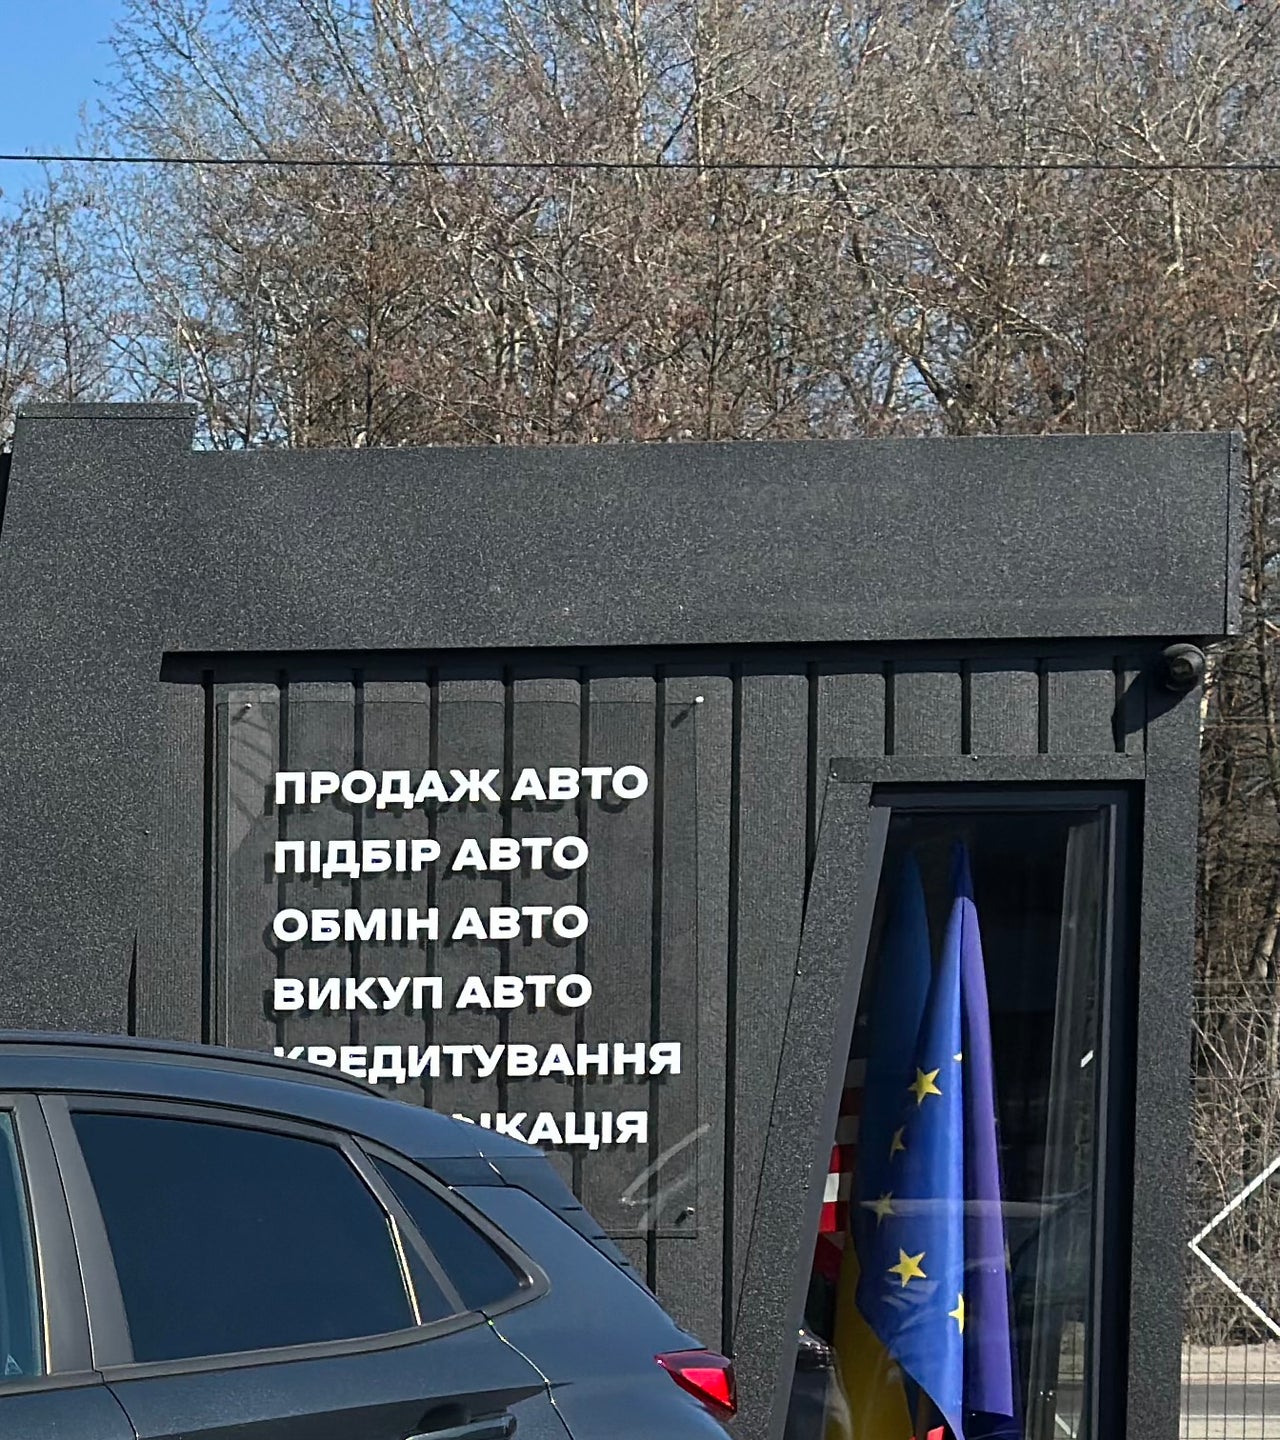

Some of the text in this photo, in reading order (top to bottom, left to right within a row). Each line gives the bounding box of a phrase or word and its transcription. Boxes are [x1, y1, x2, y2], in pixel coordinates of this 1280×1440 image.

[274, 765, 650, 809] ПРОДАЖ АВТО
[274, 835, 590, 878] ПІДБІР АВТО
[273, 905, 590, 943] ОБМІН АВТО
[274, 973, 593, 1012] ВИКУП АВТО
[451, 1110, 648, 1150] КАЦІЯ
